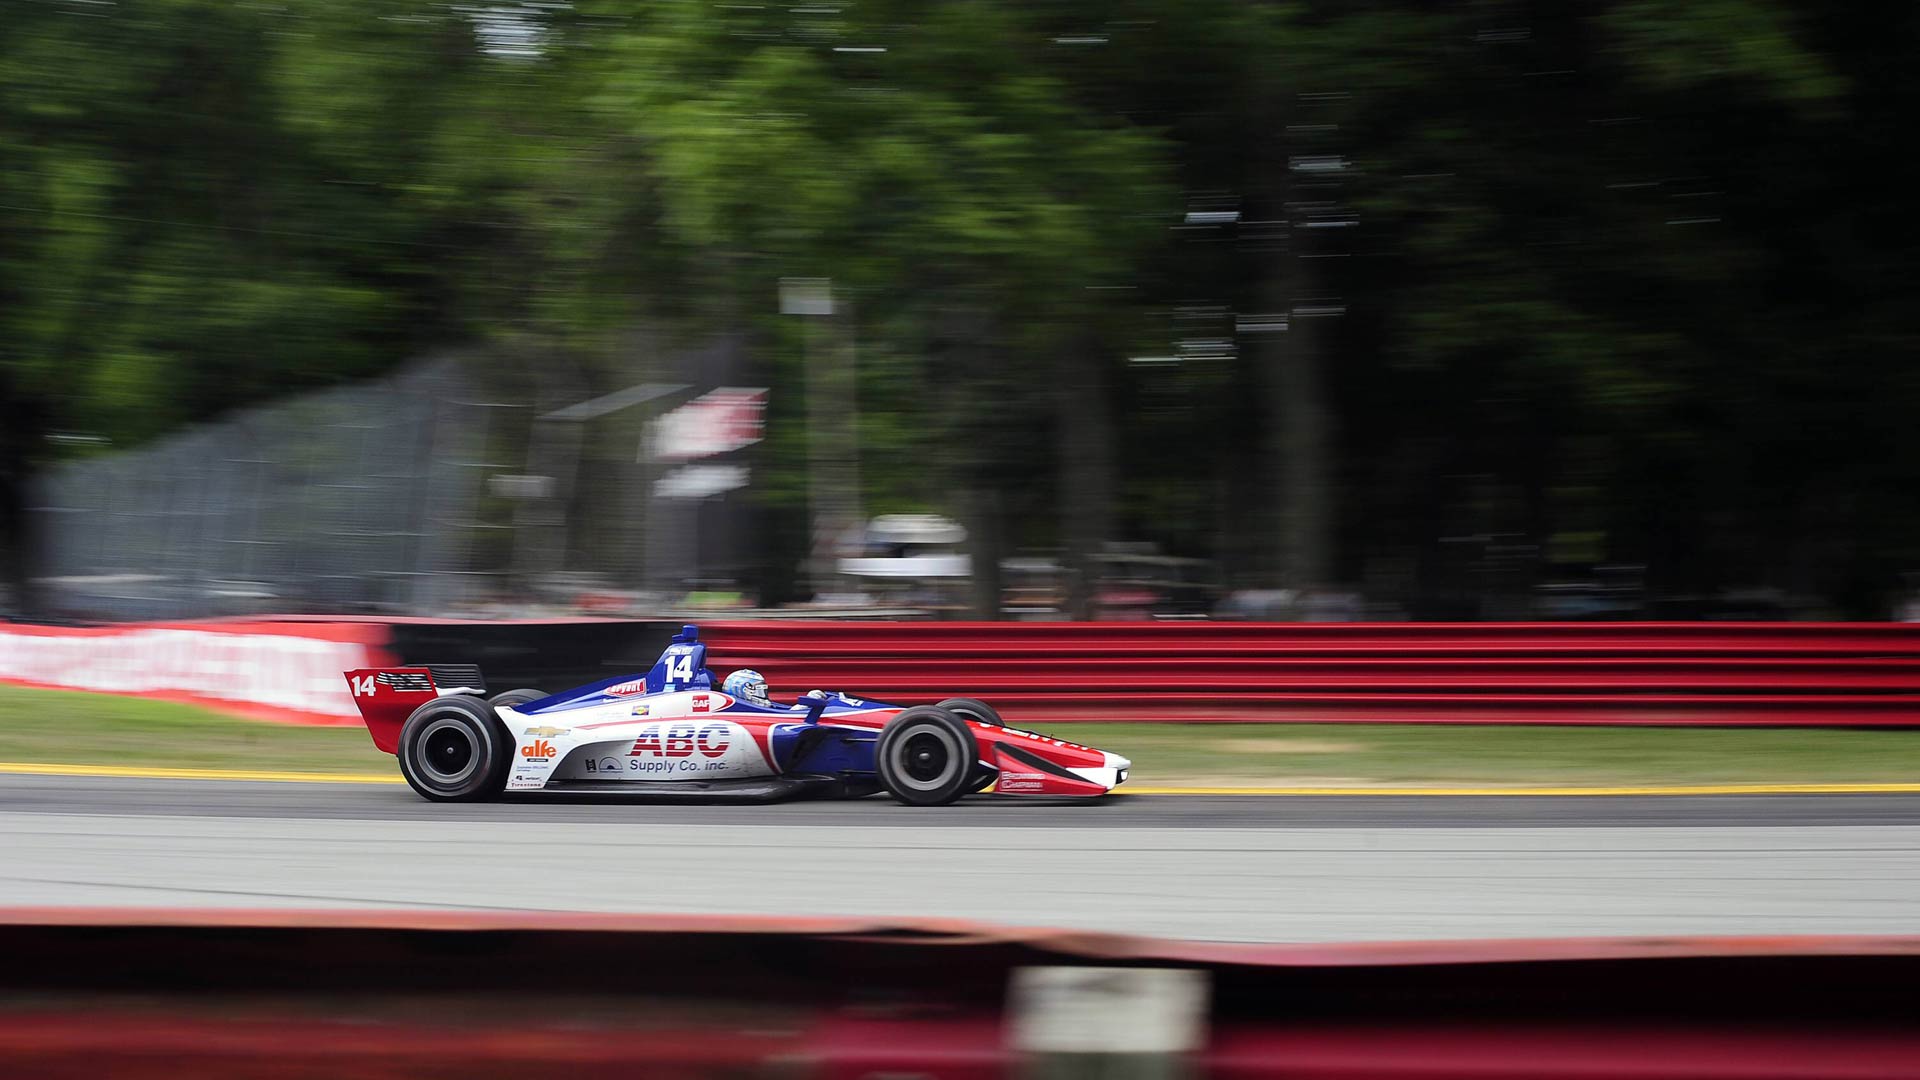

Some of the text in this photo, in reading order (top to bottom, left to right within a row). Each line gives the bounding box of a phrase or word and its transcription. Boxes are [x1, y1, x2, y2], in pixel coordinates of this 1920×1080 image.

[665, 655, 693, 683] 14
[351, 675, 376, 697] 14
[692, 699, 709, 708] GAF
[521, 740, 557, 758] alfe
[626, 724, 730, 758] ABC
[630, 760, 729, 774] Supply Co. inc.
